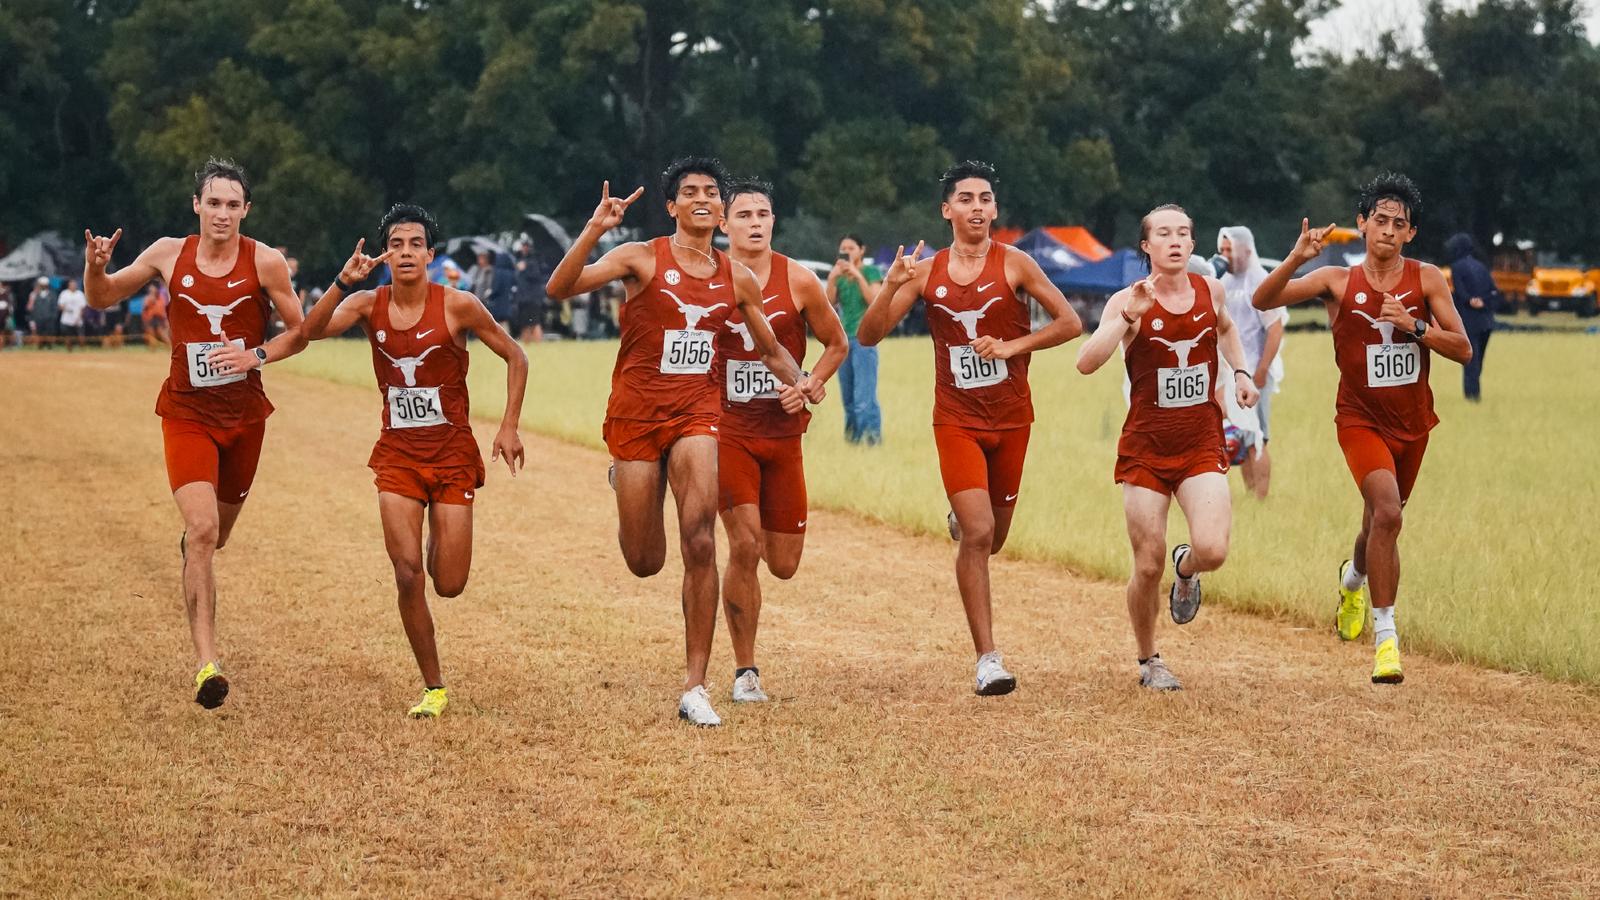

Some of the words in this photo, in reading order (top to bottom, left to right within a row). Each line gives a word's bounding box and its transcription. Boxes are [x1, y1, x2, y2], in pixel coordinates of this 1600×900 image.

[670, 341, 710, 364] 5156
[960, 356, 997, 379] 5161
[1375, 353, 1414, 378] 5160
[735, 371, 774, 393] 5155
[1166, 374, 1204, 399] 5165
[396, 396, 437, 419] 5164
